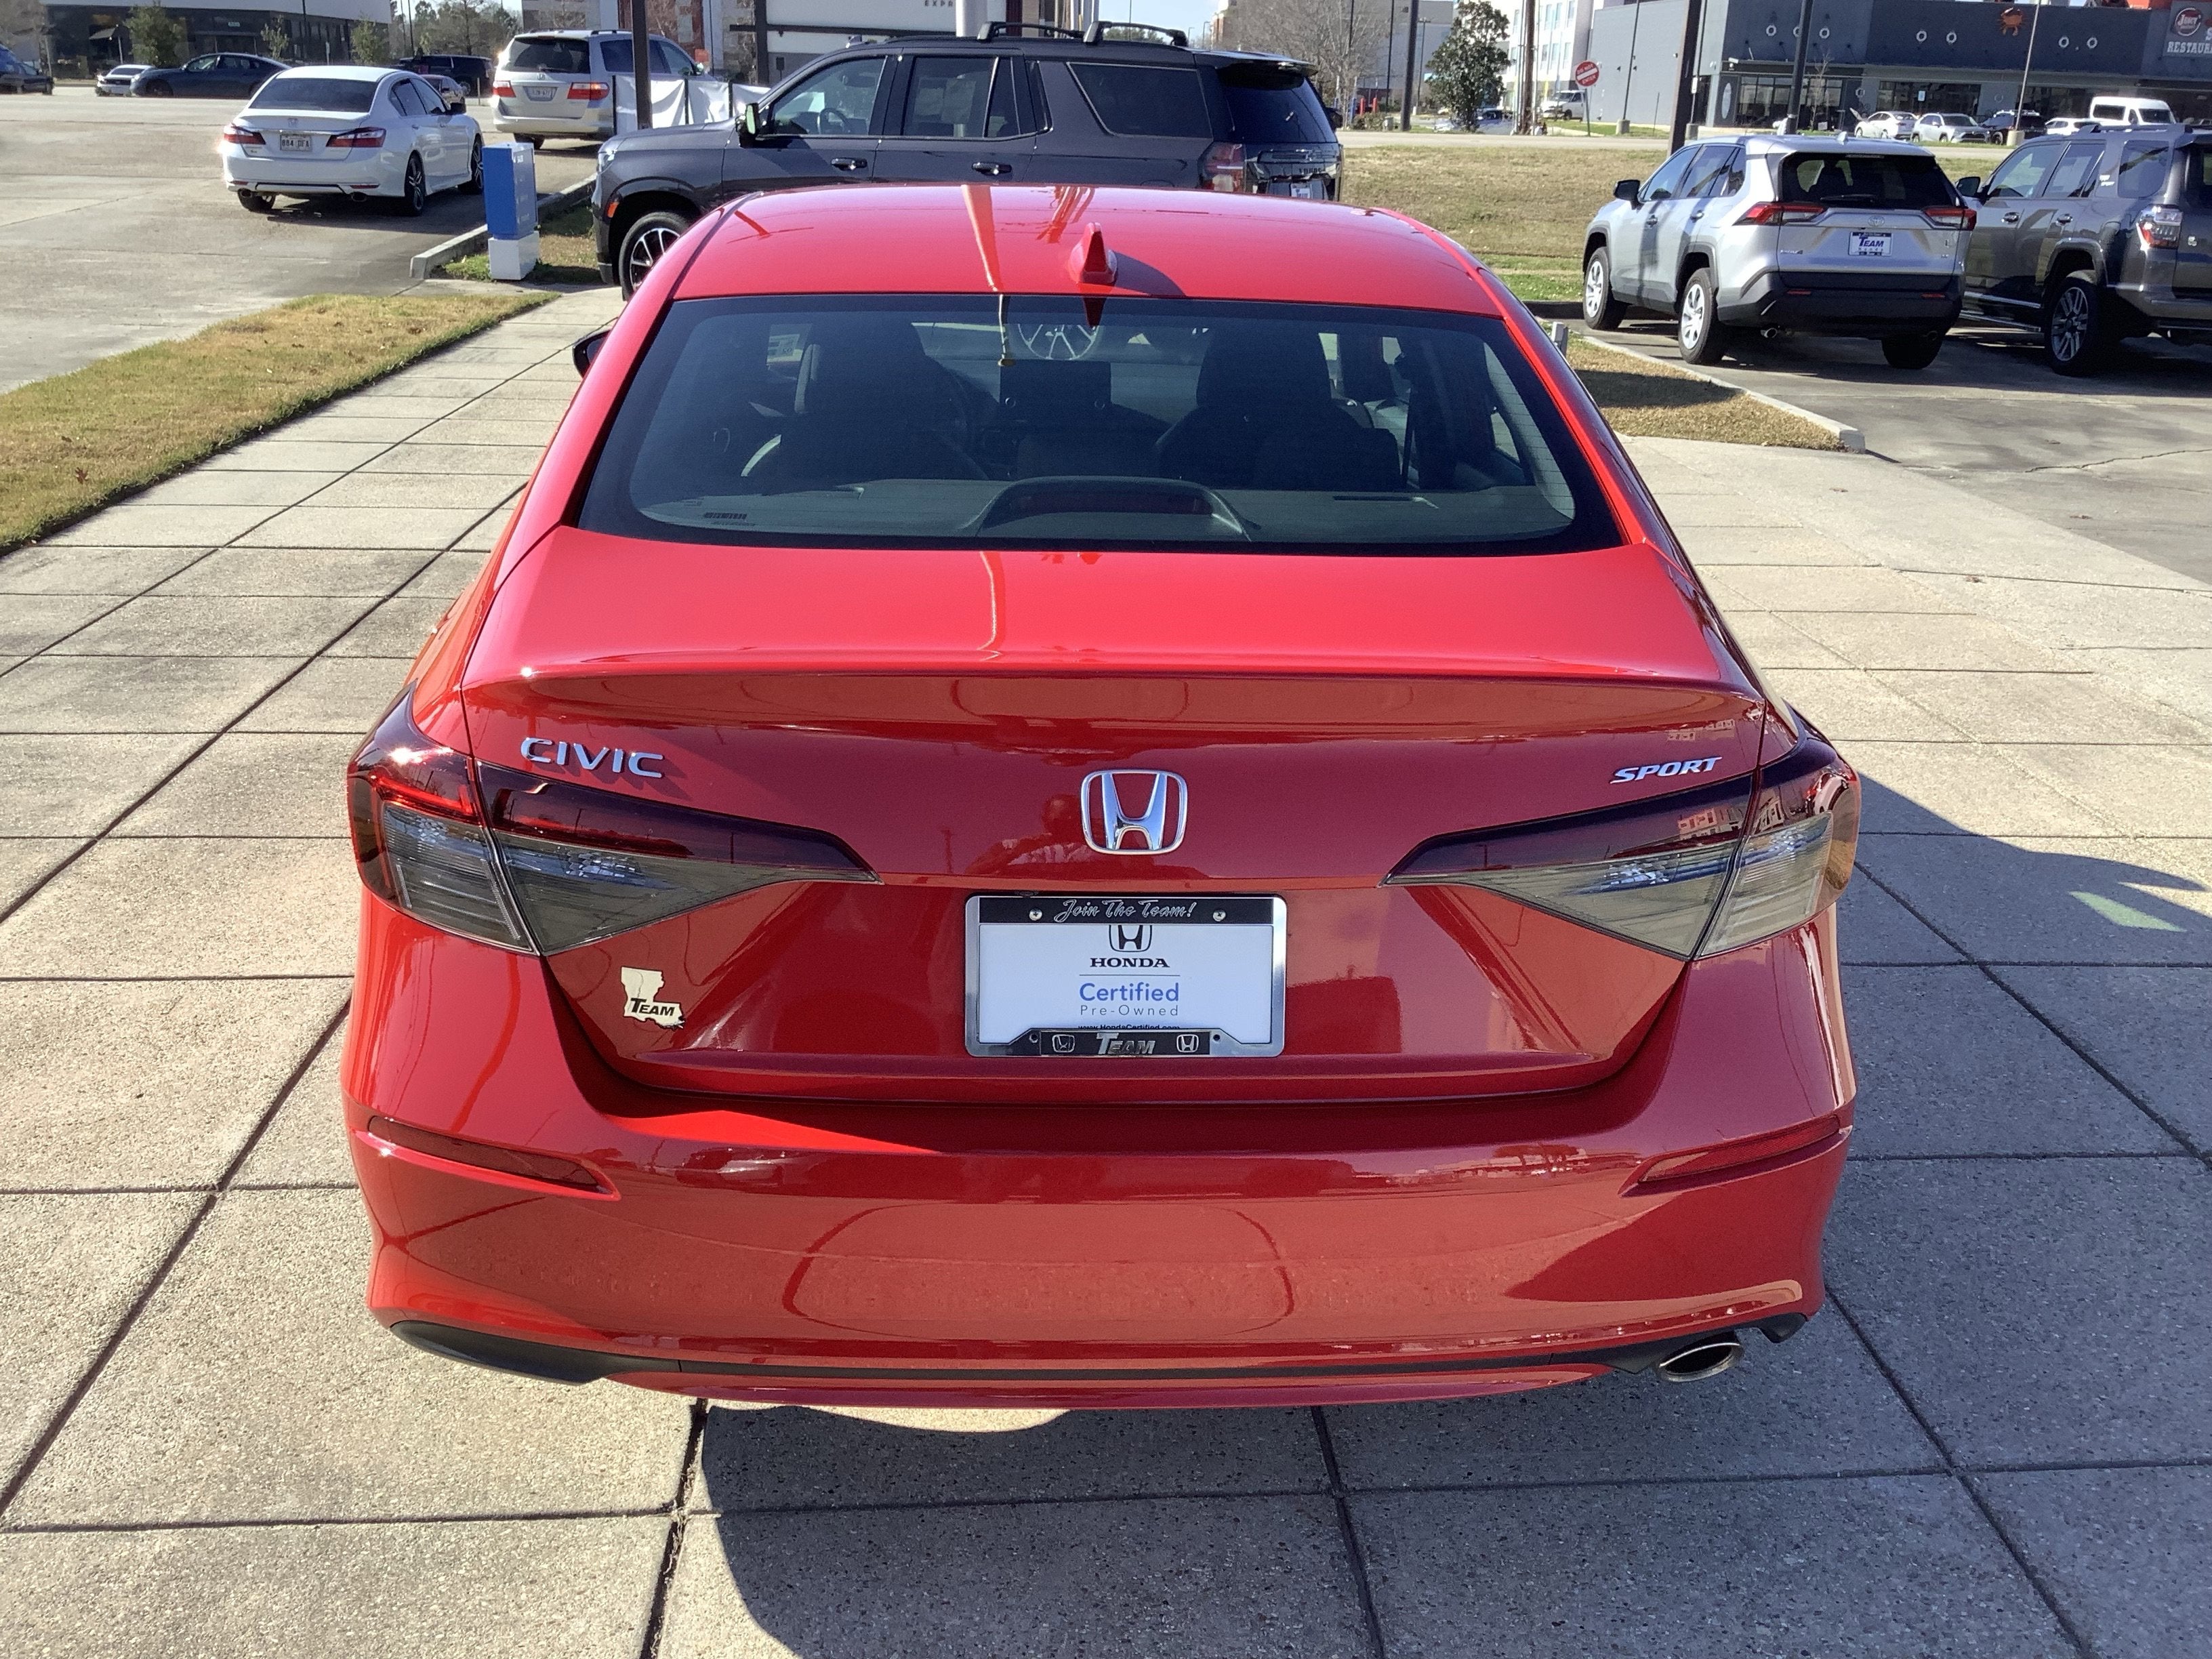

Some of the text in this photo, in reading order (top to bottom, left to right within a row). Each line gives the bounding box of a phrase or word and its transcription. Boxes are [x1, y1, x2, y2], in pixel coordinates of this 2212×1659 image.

[1582, 75, 1596, 84] ENTER
[1858, 234, 1884, 247] TEAM
[520, 737, 664, 778] CIVIC
[1610, 756, 1723, 784] SPORT
[1053, 899, 1197, 922] Join The Team!
[1090, 958, 1170, 968] HONDA
[1079, 982, 1179, 1002] Certified
[630, 998, 676, 1017] TEAM
[1080, 1005, 1179, 1016] Pre-Owned
[1096, 1032, 1156, 1055] TEAM
